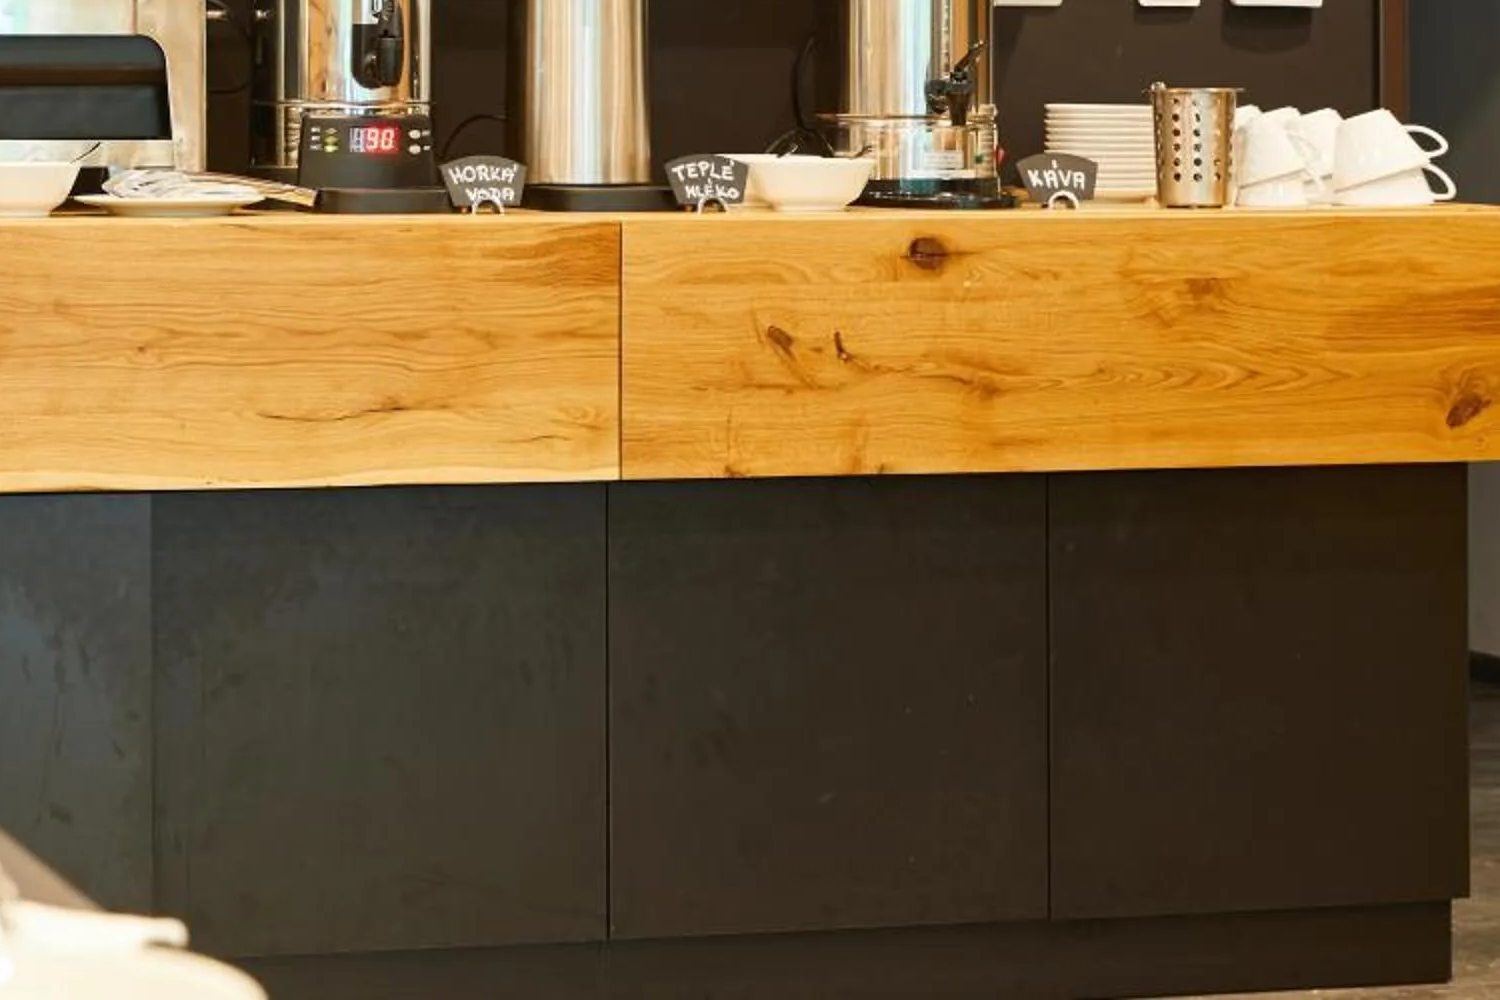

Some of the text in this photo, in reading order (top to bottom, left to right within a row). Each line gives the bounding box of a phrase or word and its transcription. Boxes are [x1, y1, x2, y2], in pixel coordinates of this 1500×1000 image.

[366, 127, 396, 151] 90
[448, 163, 517, 185] HORKÁ
[671, 159, 734, 182] TEPLÉ
[1027, 159, 1086, 191] KÁVA
[465, 187, 515, 202] VODA
[685, 177, 740, 199] MLÉKO
